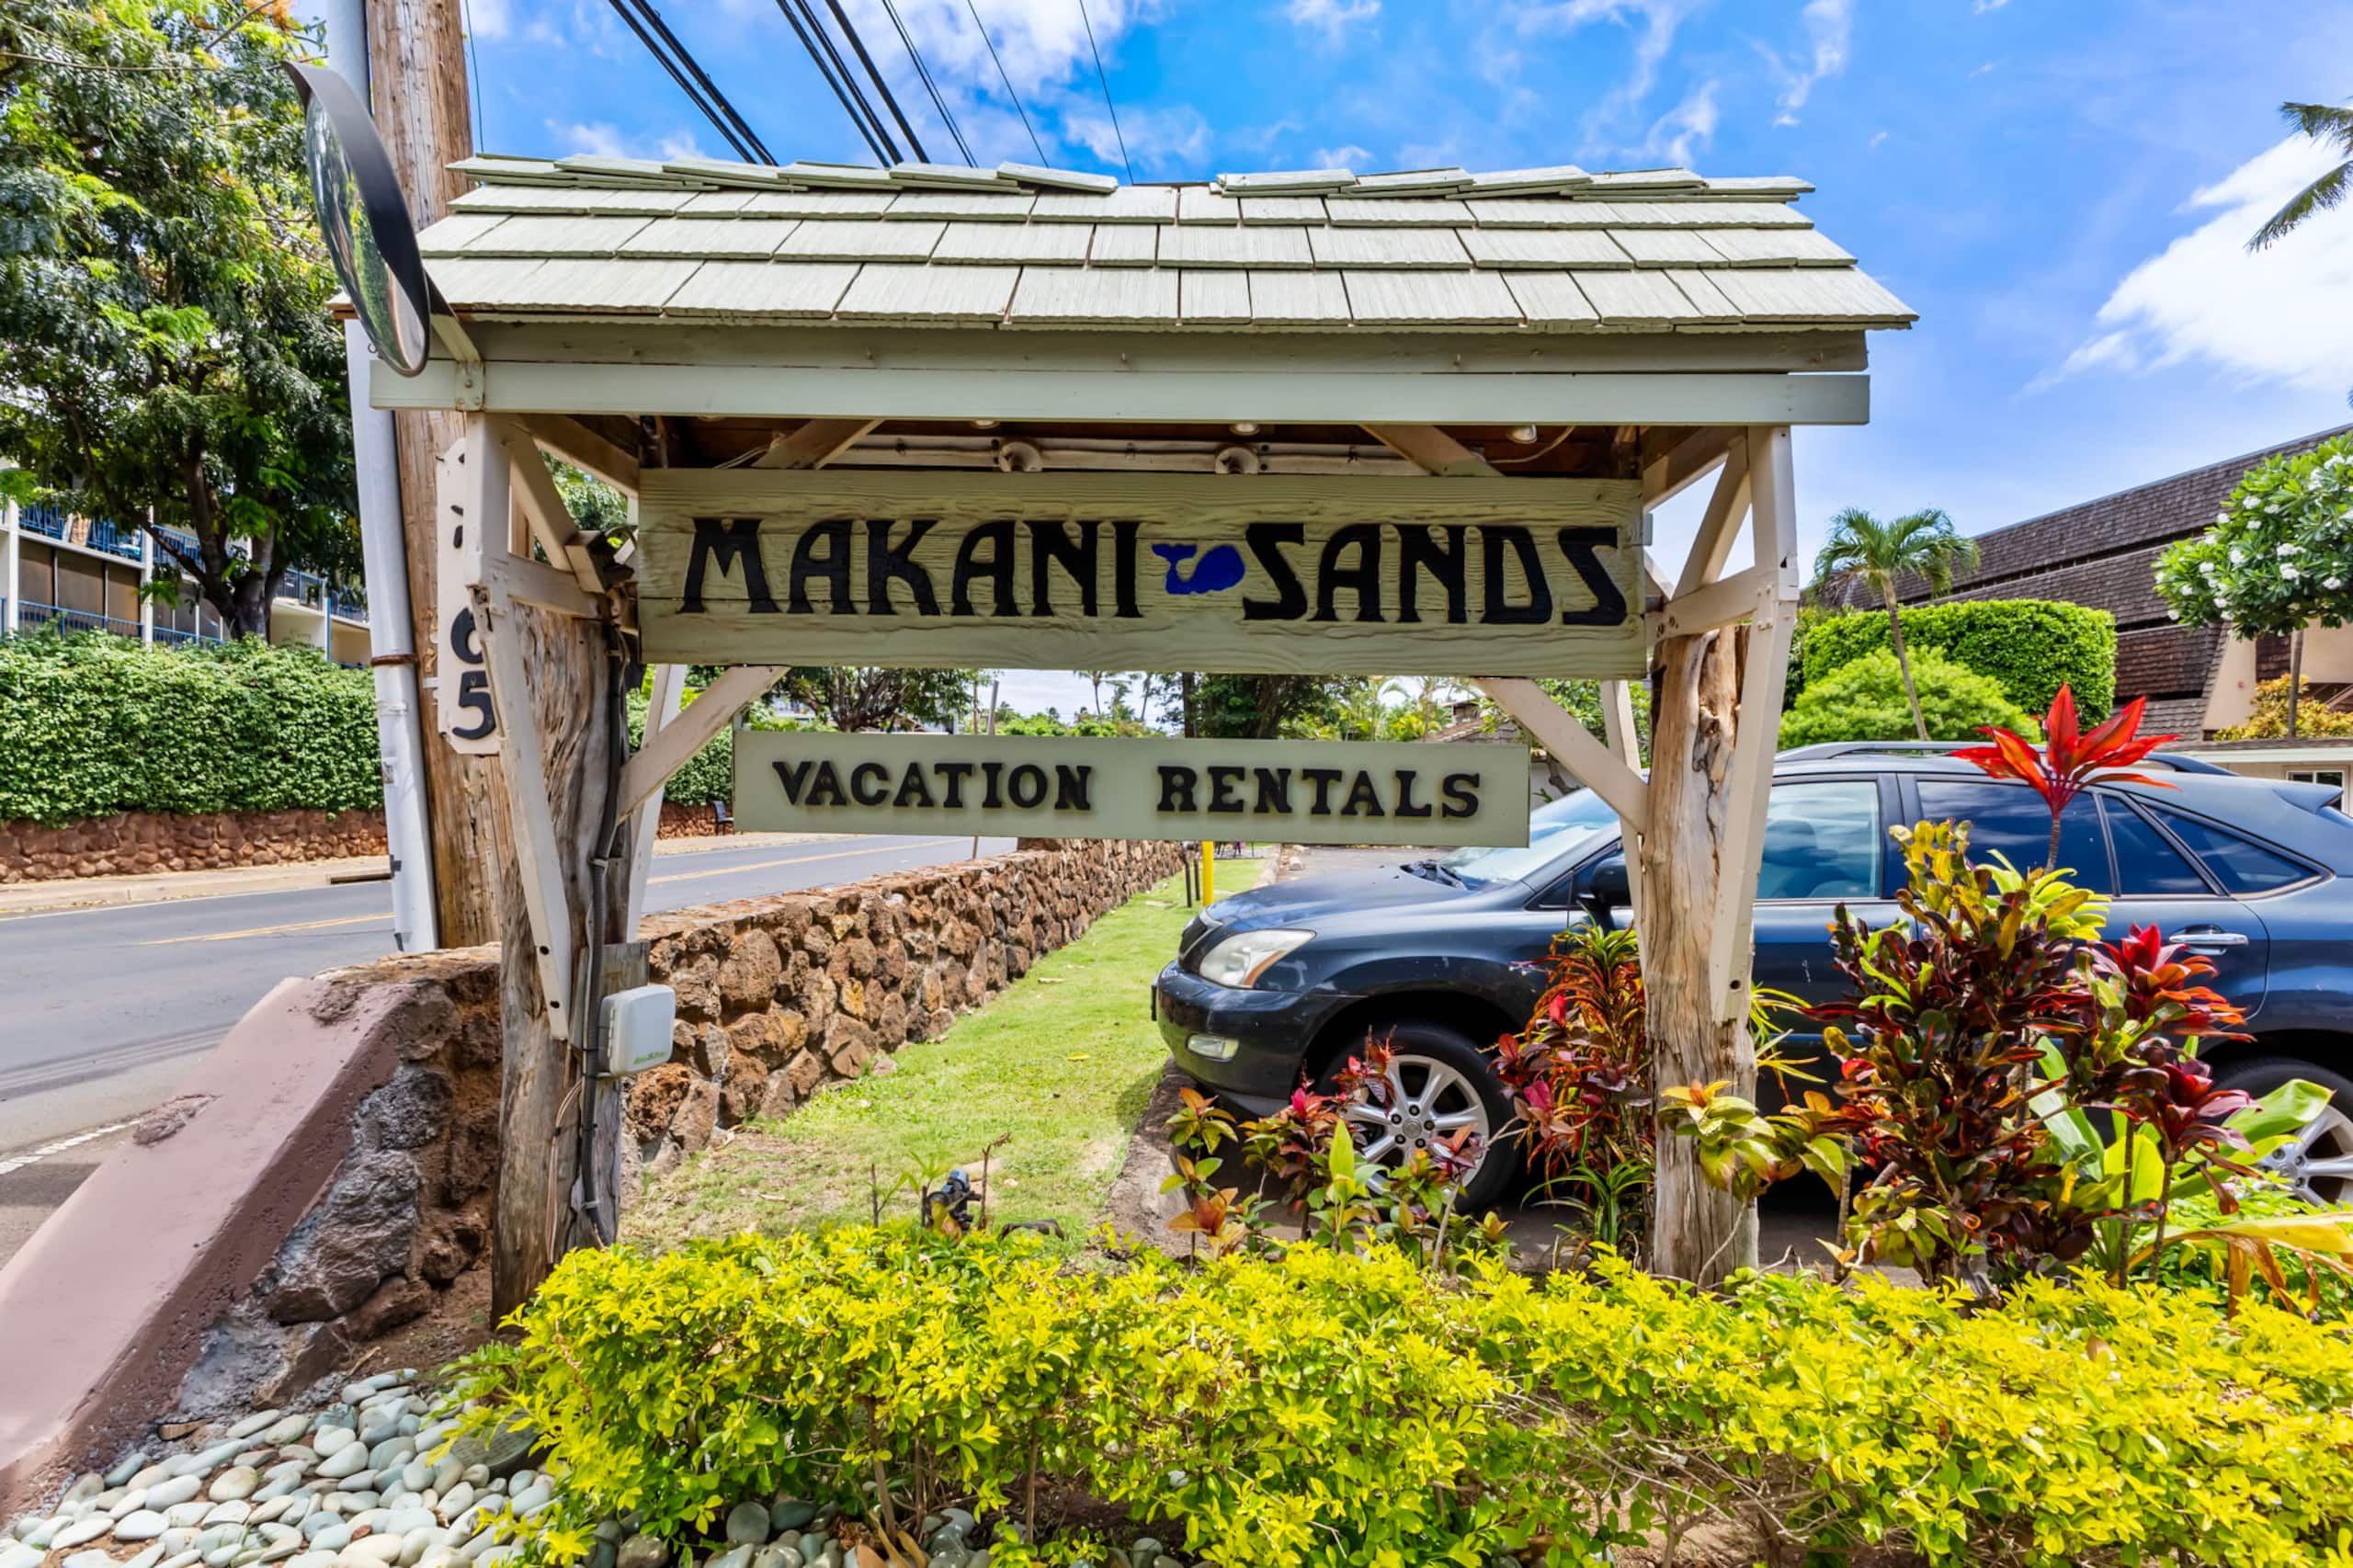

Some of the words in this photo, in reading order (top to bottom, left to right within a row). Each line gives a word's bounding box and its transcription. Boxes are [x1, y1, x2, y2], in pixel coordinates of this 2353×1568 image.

[676, 517, 1143, 619] MAKANI
[1244, 521, 1628, 627] SANDS
[772, 761, 1093, 812] VACATION
[1156, 765, 1481, 819] RENTALS
